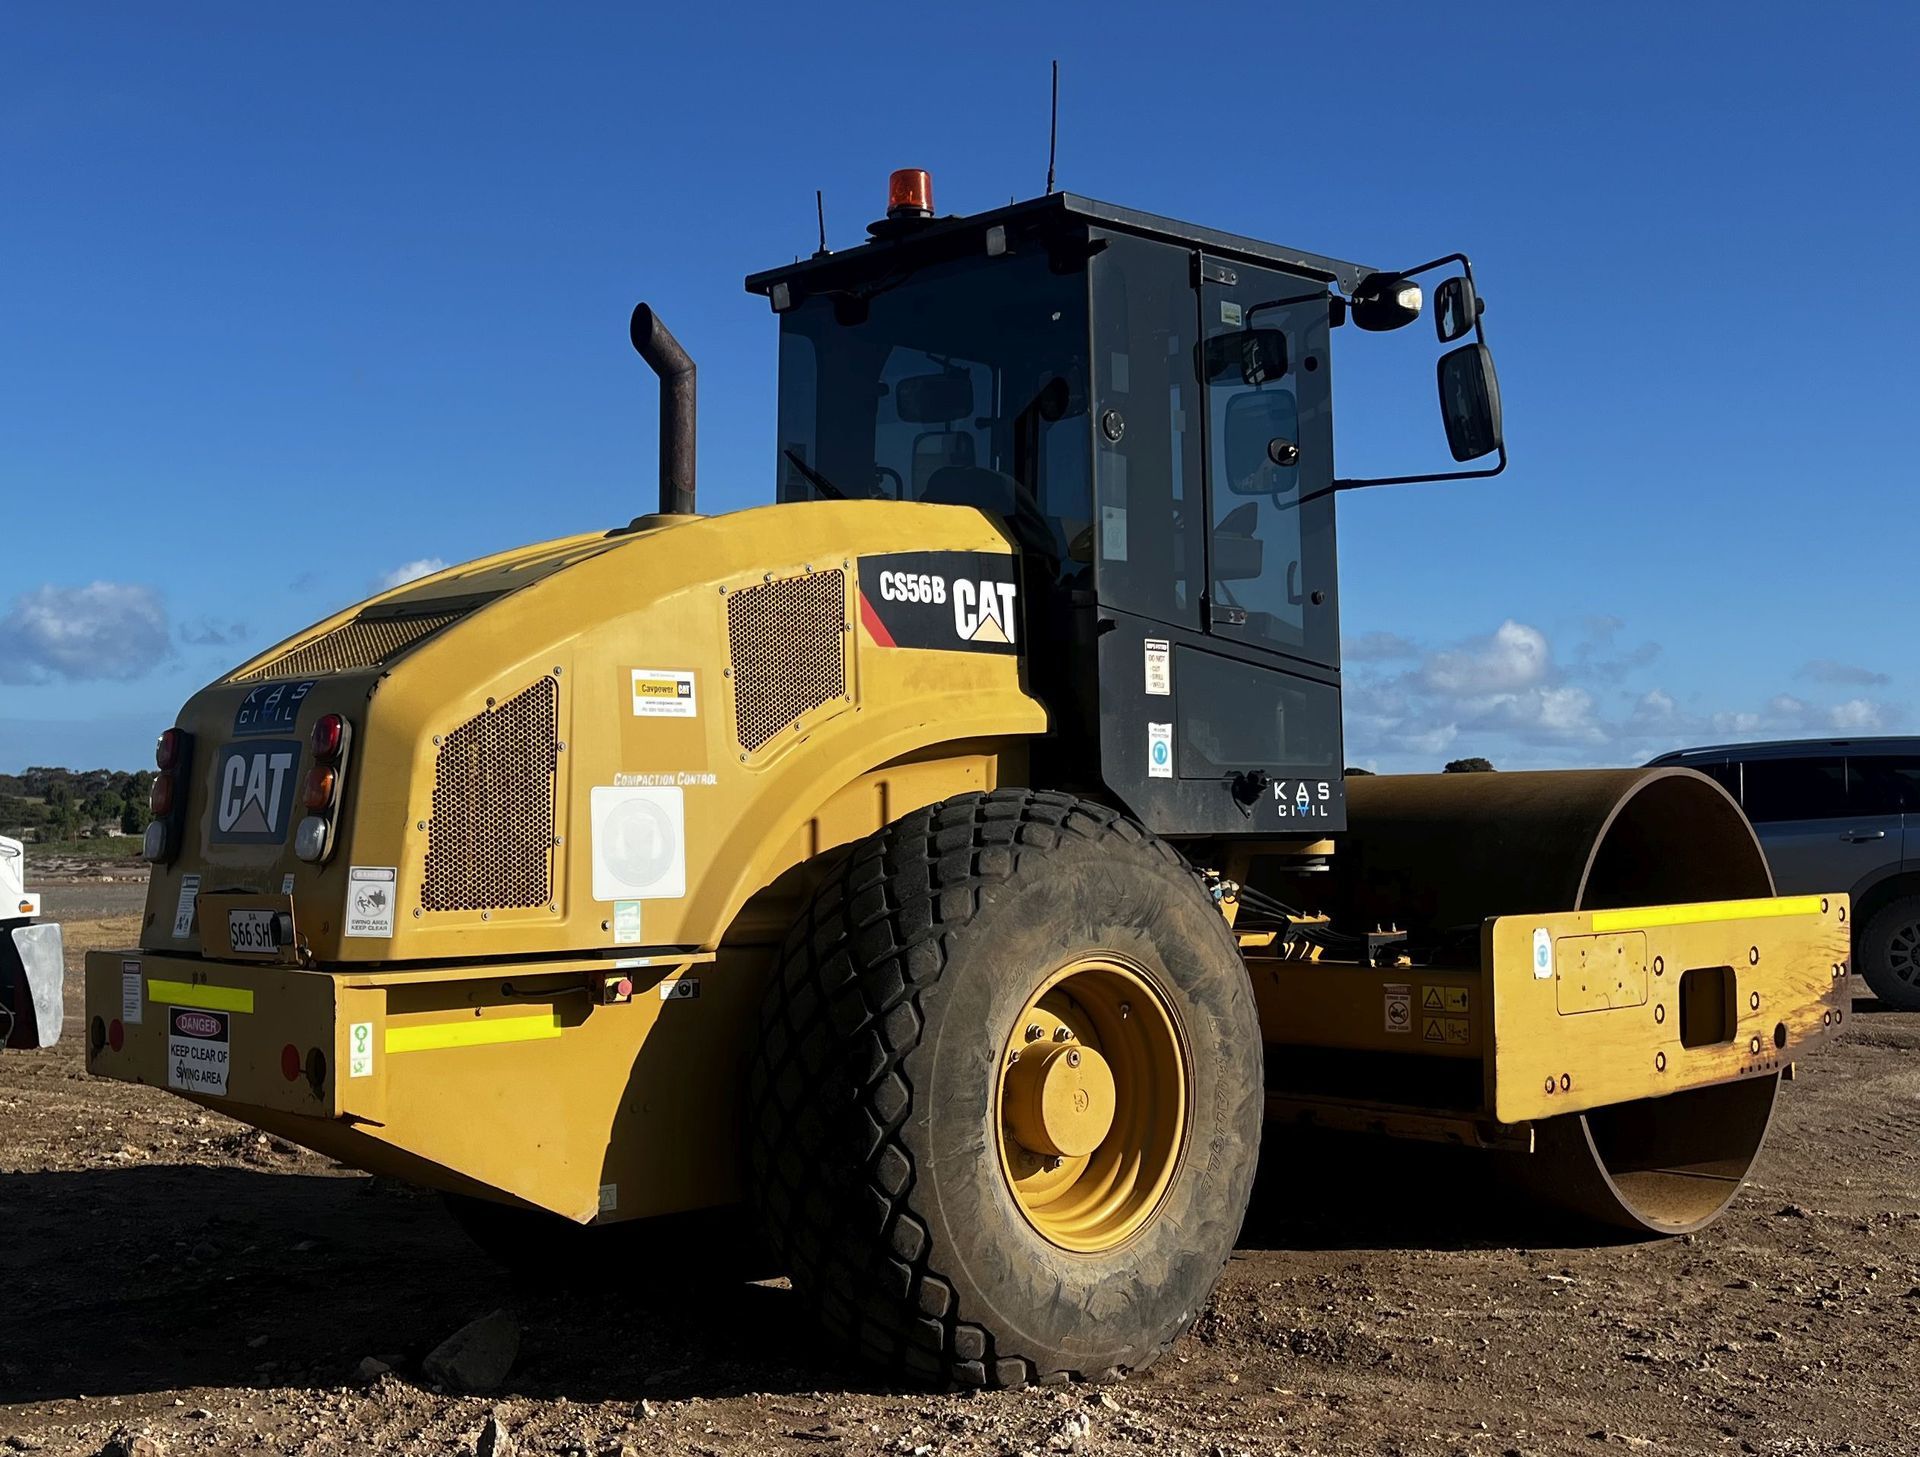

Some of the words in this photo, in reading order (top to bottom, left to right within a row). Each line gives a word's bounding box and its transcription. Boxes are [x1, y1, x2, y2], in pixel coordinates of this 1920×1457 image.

[880, 571, 946, 604] CS56B
[953, 579, 1016, 644] CAT
[244, 682, 314, 704] KAS
[641, 684, 674, 694] Cavpower
[678, 684, 690, 694] CAT
[613, 772, 675, 786] COMPACTION
[677, 772, 717, 785] CONTROL
[219, 753, 292, 832] CAT
[1274, 782, 1330, 800] KAS
[181, 1016, 217, 1033] DANGER
[171, 1043, 190, 1058] KEEP
[191, 1046, 216, 1062] CLEAR
[217, 1050, 228, 1063] OF
[201, 1070, 223, 1085] AREA
